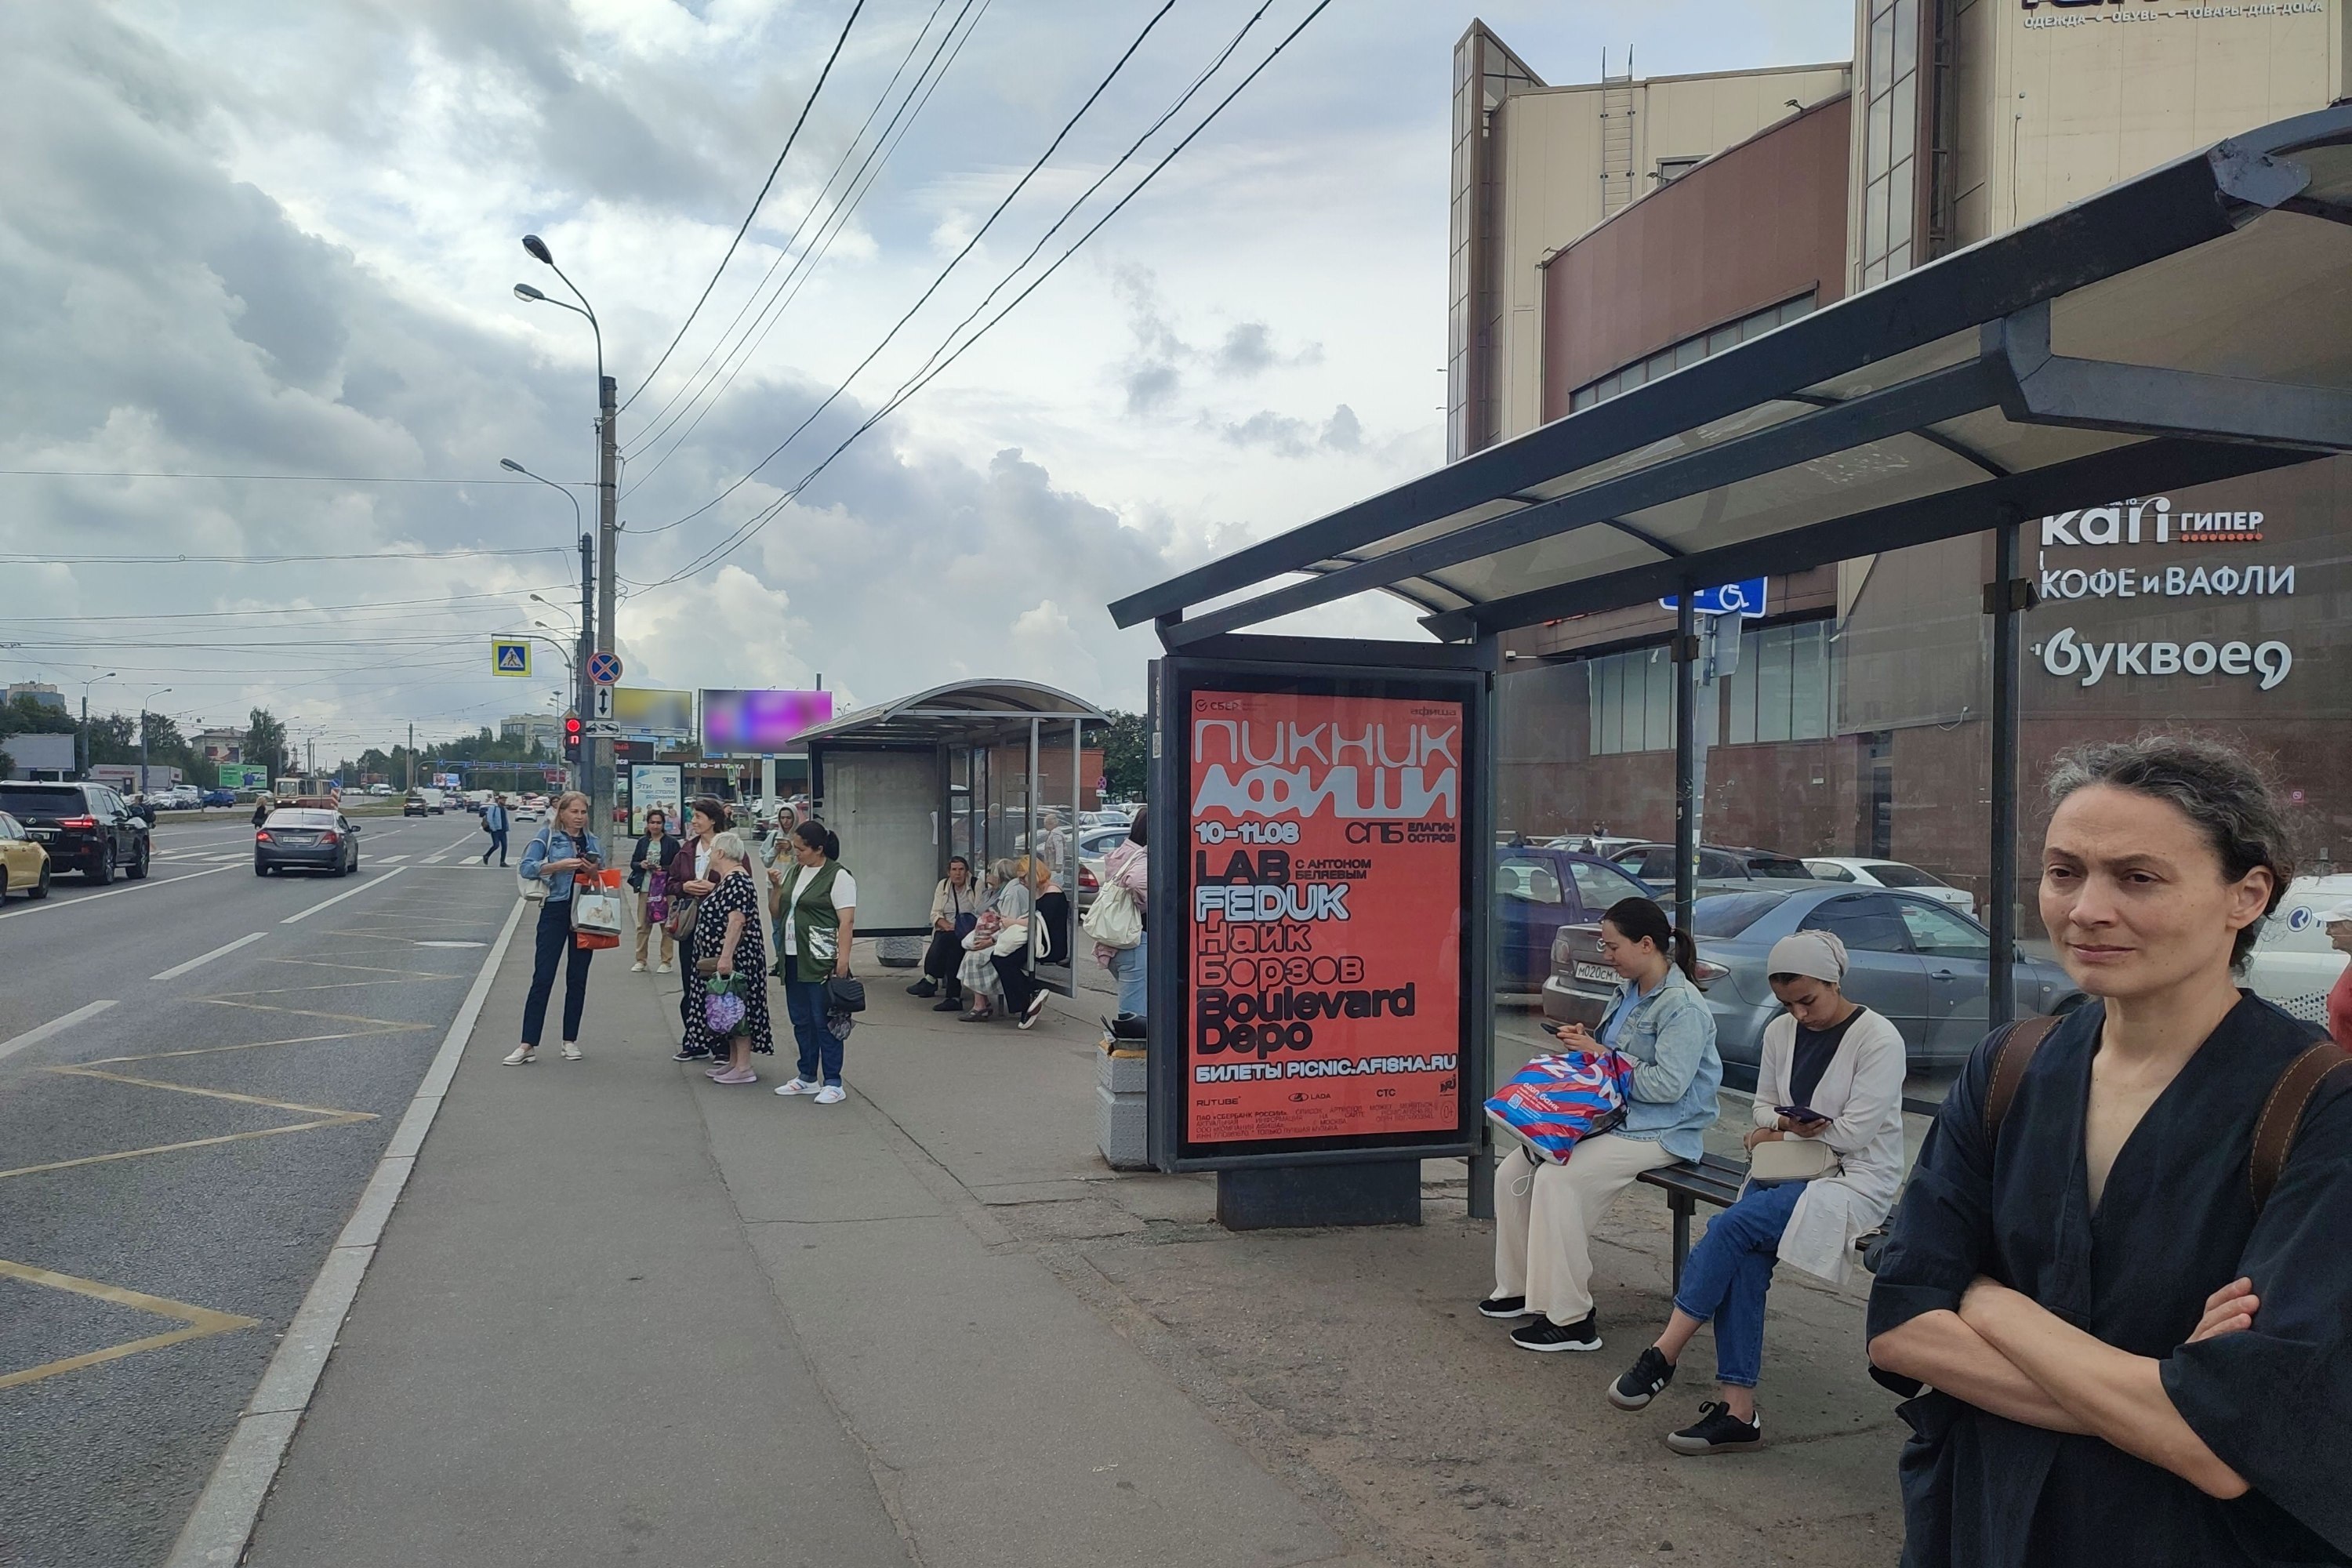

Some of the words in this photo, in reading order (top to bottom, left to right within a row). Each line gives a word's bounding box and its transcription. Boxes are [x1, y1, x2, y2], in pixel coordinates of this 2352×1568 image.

[2024, 16, 2085, 29] ОДЕЖДА
[2111, 10, 2158, 23] ОБУВЬ
[2184, 6, 2243, 19] ТОВАРЫ
[2247, 4, 2277, 17] ДЛЯ
[2281, 2, 2323, 16] ДОМА
[2042, 496, 2171, 546] kari
[2180, 511, 2264, 532] ГИПЕР
[2041, 568, 2136, 599] КОФЕ
[2165, 564, 2295, 596] ВАФЛИ
[1195, 720, 1457, 767] ПИКНИК
[1192, 764, 1456, 818] АФИШИ
[1345, 822, 1404, 844] СПБ
[1407, 822, 1454, 832] ЕЛАГИН
[1407, 833, 1456, 843] ОСТРОВ
[1196, 850, 1290, 885] LAB
[1295, 869, 1367, 880] БЕЛЯЕВЫМ
[1307, 859, 1372, 869] АНТОНОМ
[1194, 884, 1351, 922] FEDUK
[1196, 982, 1415, 1022] Boulevard
[1196, 1021, 1313, 1059] Depo
[1195, 1062, 1282, 1083] БИЛЕТЫ
[1287, 1054, 1457, 1078] PICNIC.AFISHA.RU
[1523, 1083, 1540, 1096] ozon
[1539, 1094, 1560, 1112] банк
